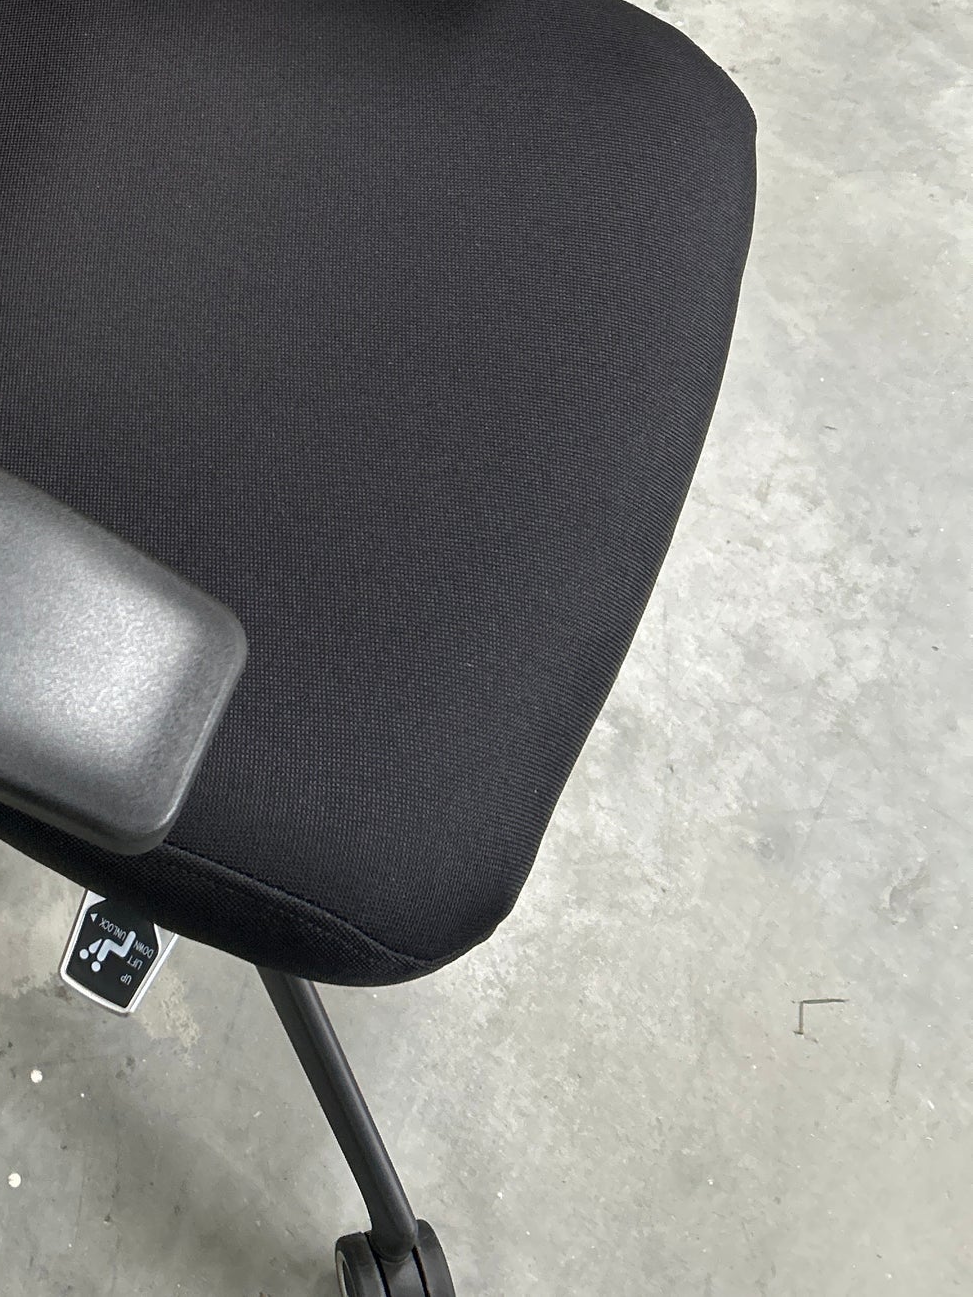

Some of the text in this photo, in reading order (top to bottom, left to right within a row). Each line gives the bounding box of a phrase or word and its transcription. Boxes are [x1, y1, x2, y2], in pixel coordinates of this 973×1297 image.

[99, 917, 127, 941] UNLOCK
[133, 940, 154, 959] DOWN
[120, 973, 132, 986] UP
